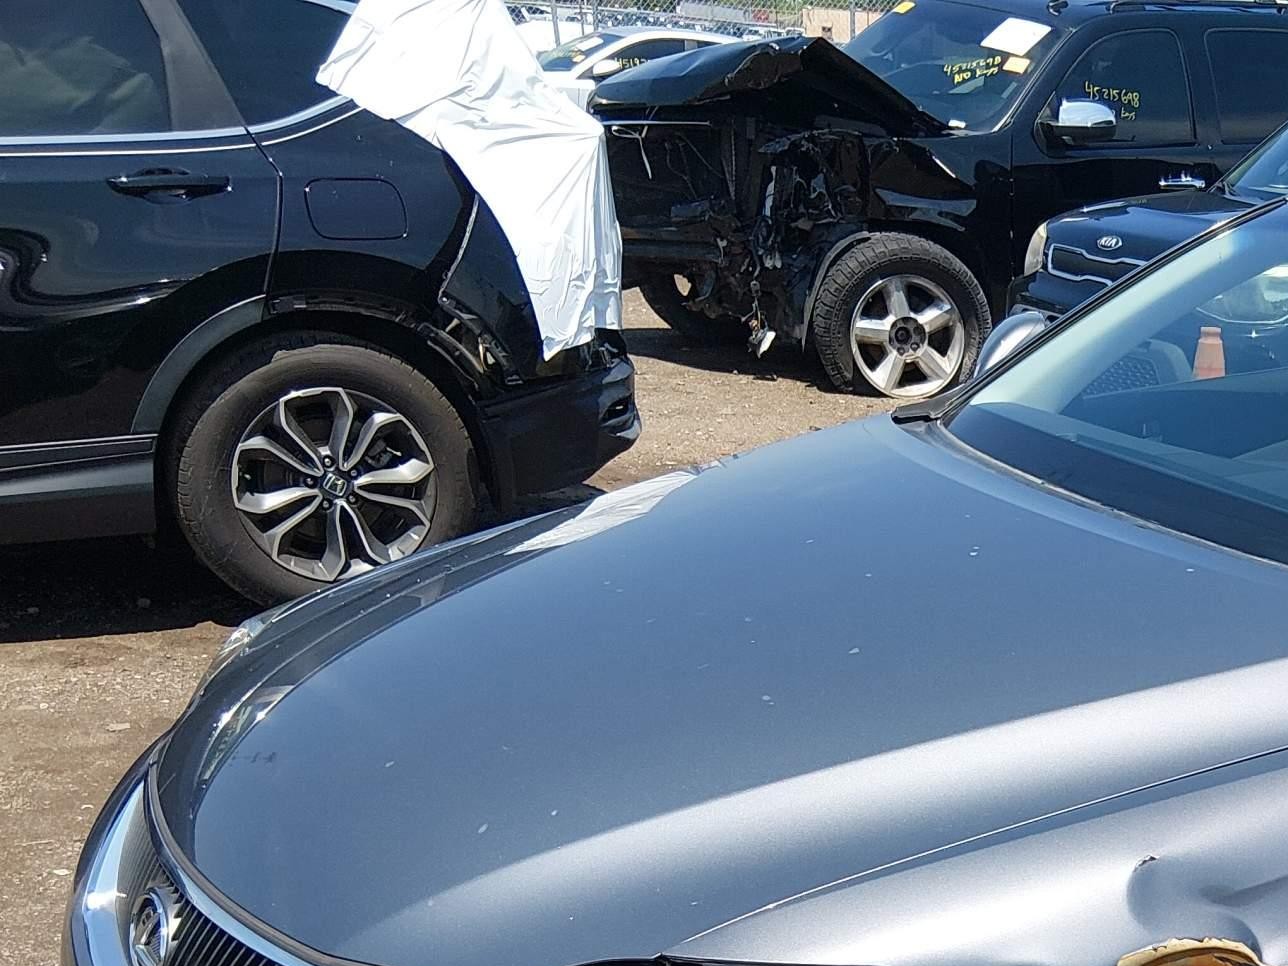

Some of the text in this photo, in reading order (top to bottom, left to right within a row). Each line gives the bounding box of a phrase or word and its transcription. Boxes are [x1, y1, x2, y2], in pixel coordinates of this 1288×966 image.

[954, 71, 972, 85] NO
[1085, 81, 1139, 107] 45215698
[1100, 237, 1117, 247] KIA
